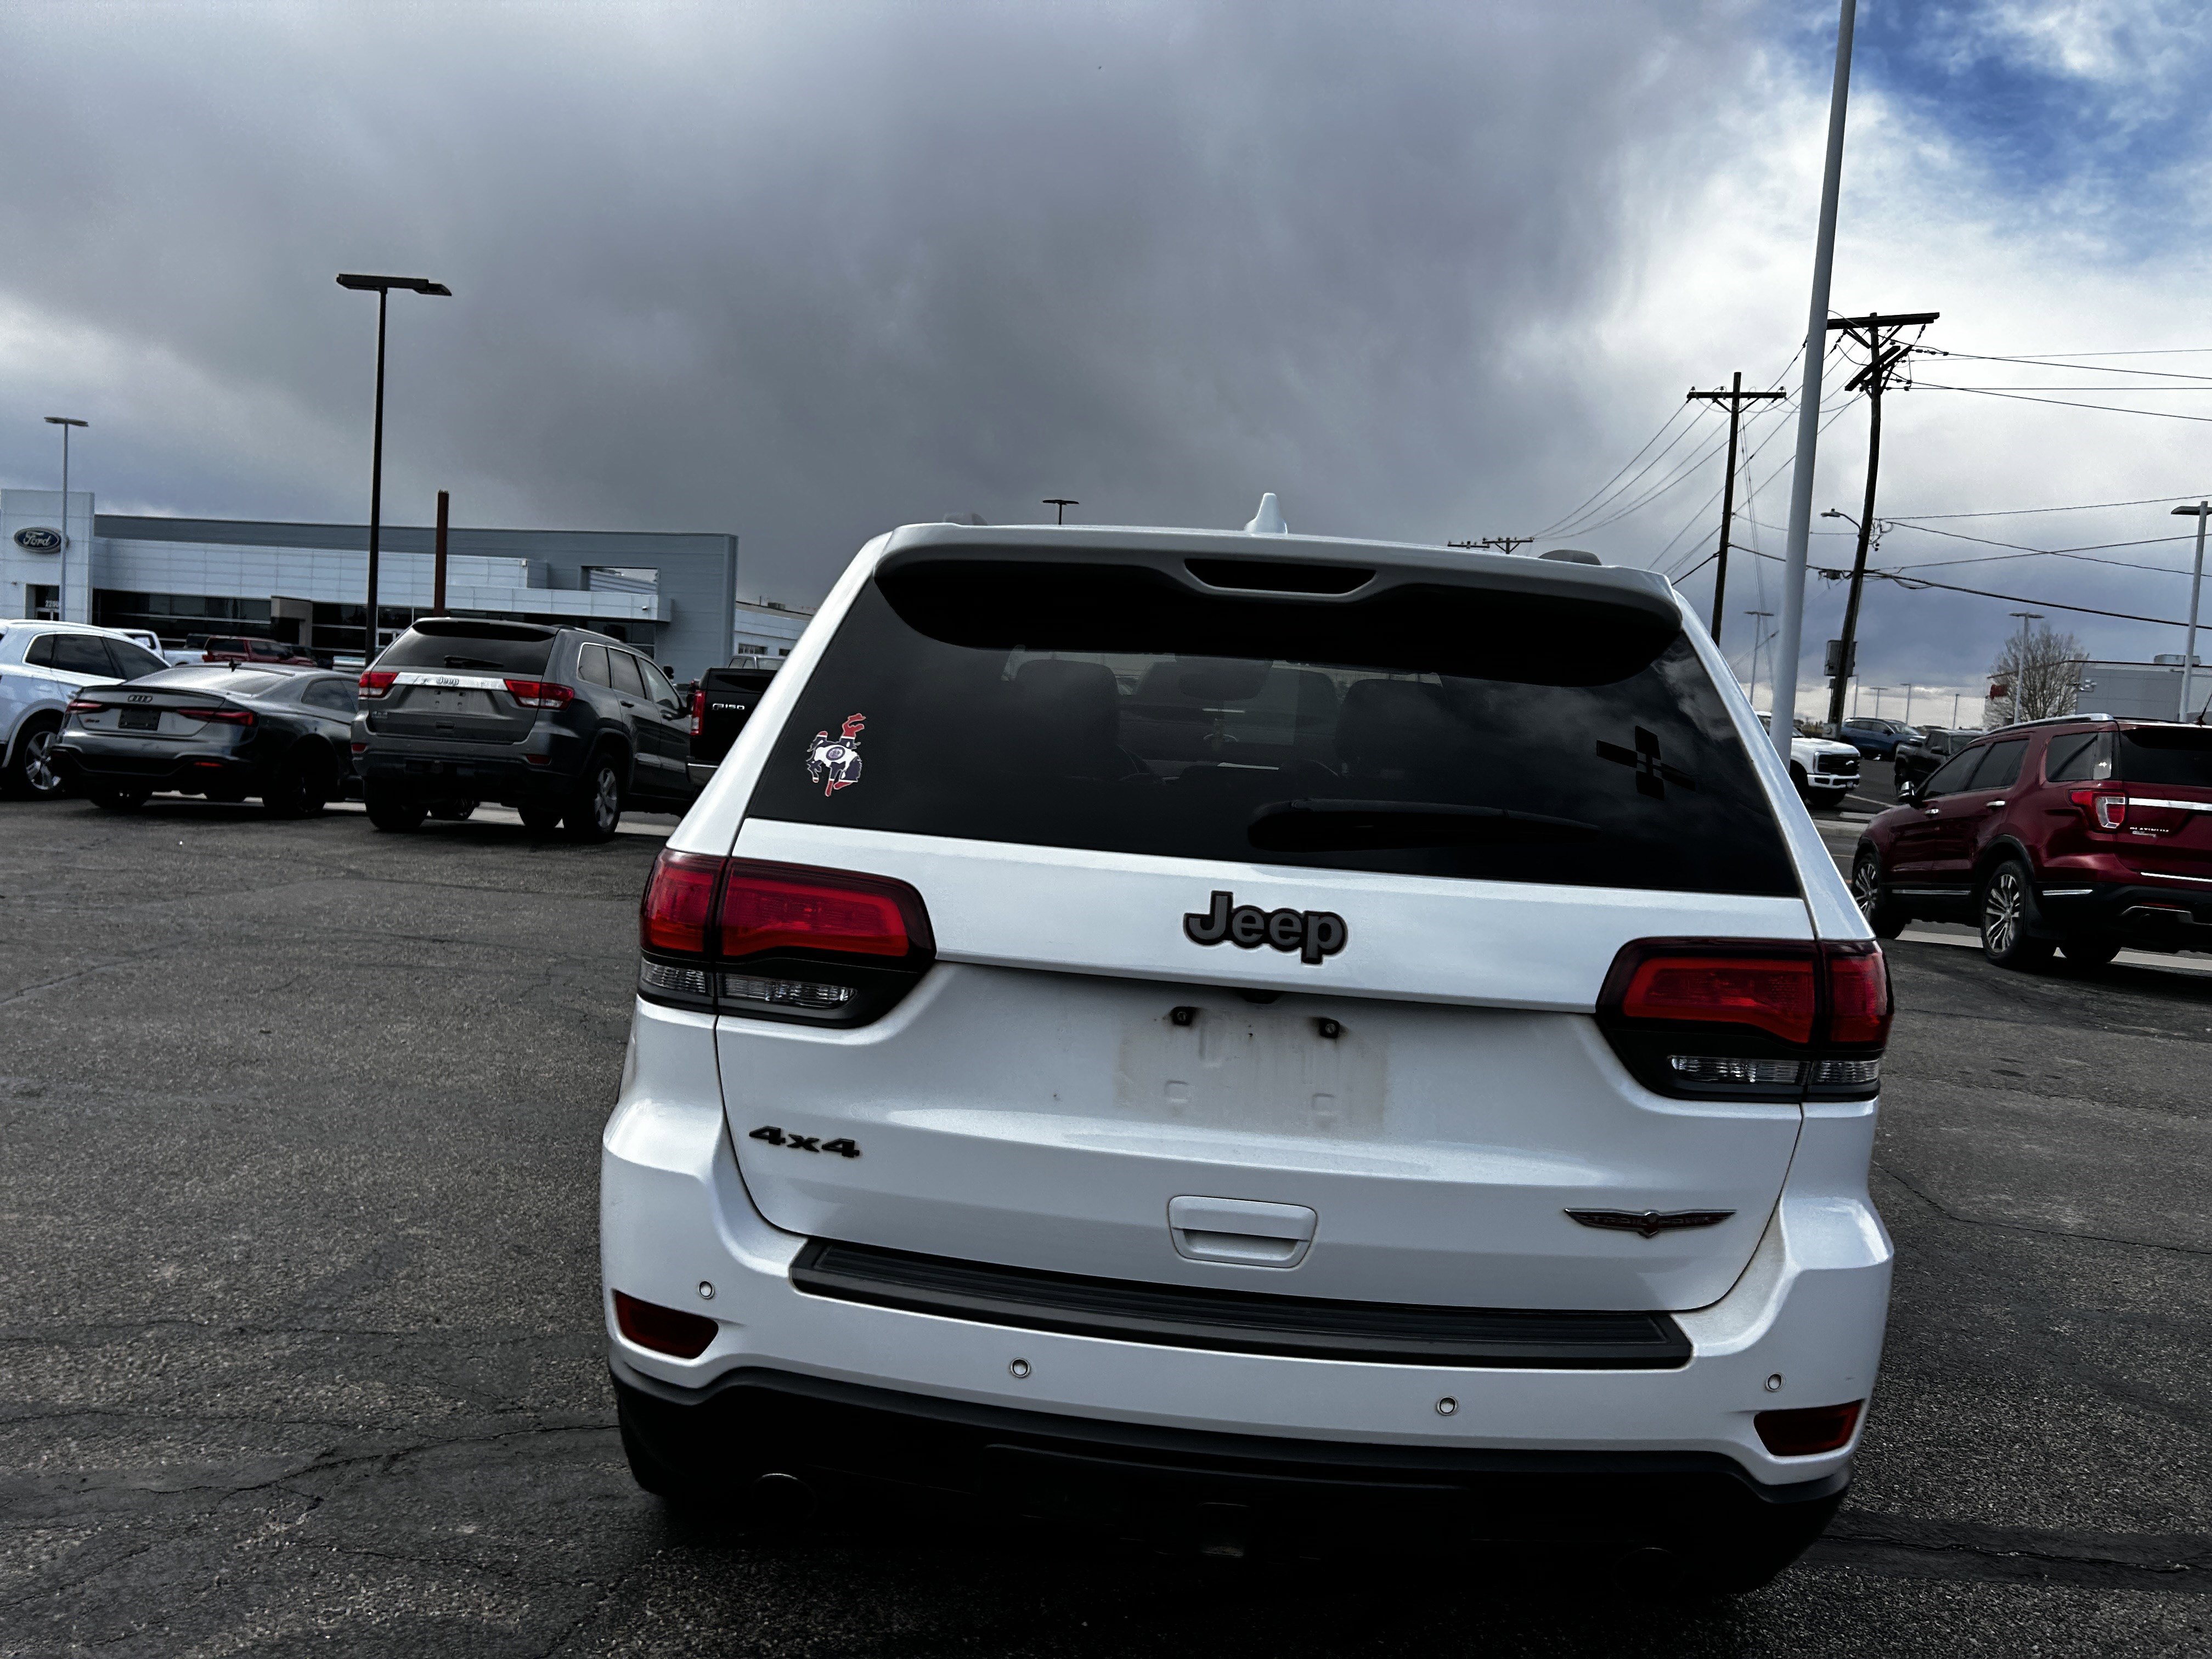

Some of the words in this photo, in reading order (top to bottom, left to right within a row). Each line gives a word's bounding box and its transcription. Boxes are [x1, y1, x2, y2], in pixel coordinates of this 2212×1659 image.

[23, 531, 51, 546] Ford
[437, 676, 459, 686] Jeep
[1183, 890, 1349, 966] Jeep
[749, 1125, 860, 1158] 4x4
